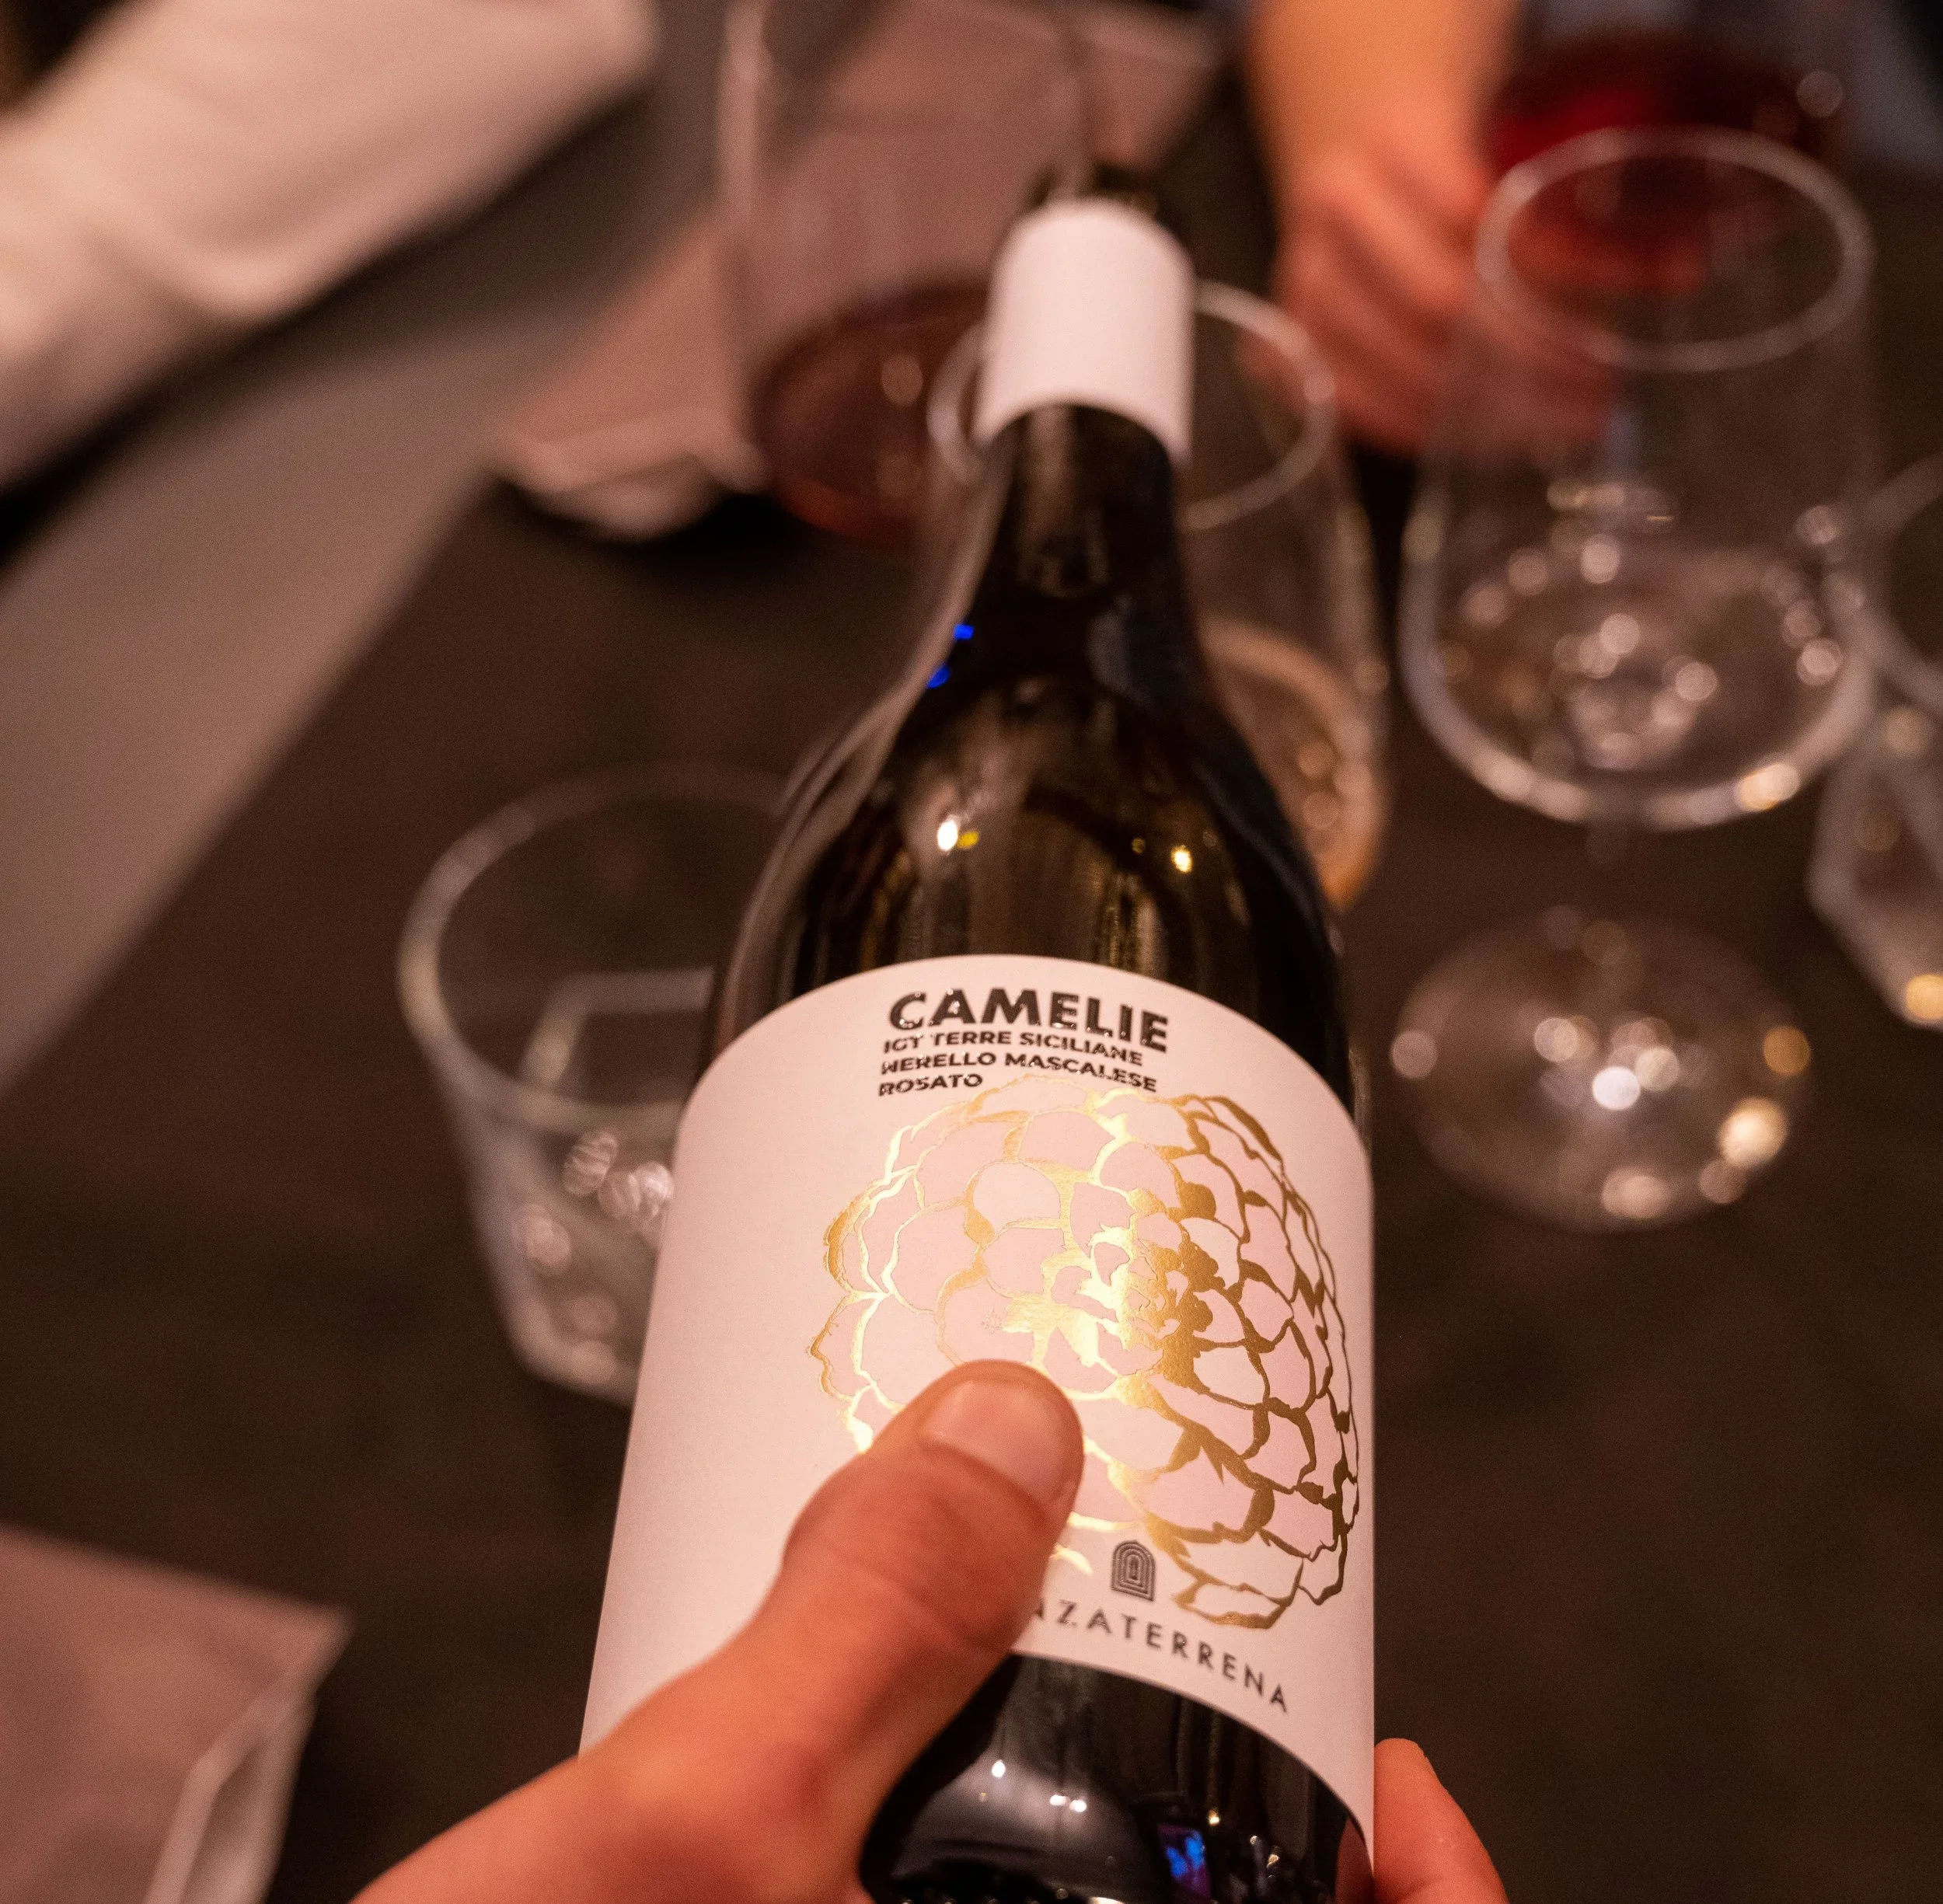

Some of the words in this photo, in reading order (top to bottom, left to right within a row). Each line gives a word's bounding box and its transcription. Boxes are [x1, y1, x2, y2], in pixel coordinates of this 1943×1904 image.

[889, 988, 1168, 1052] CAMELIE
[884, 1034, 924, 1054] IGT
[931, 1030, 1011, 1048] TERRE
[1019, 1031, 1143, 1066] SICILIANE
[878, 1073, 982, 1097] ROSATO
[881, 1052, 996, 1075] NERELLO
[1004, 1052, 1156, 1092] MASCALESE
